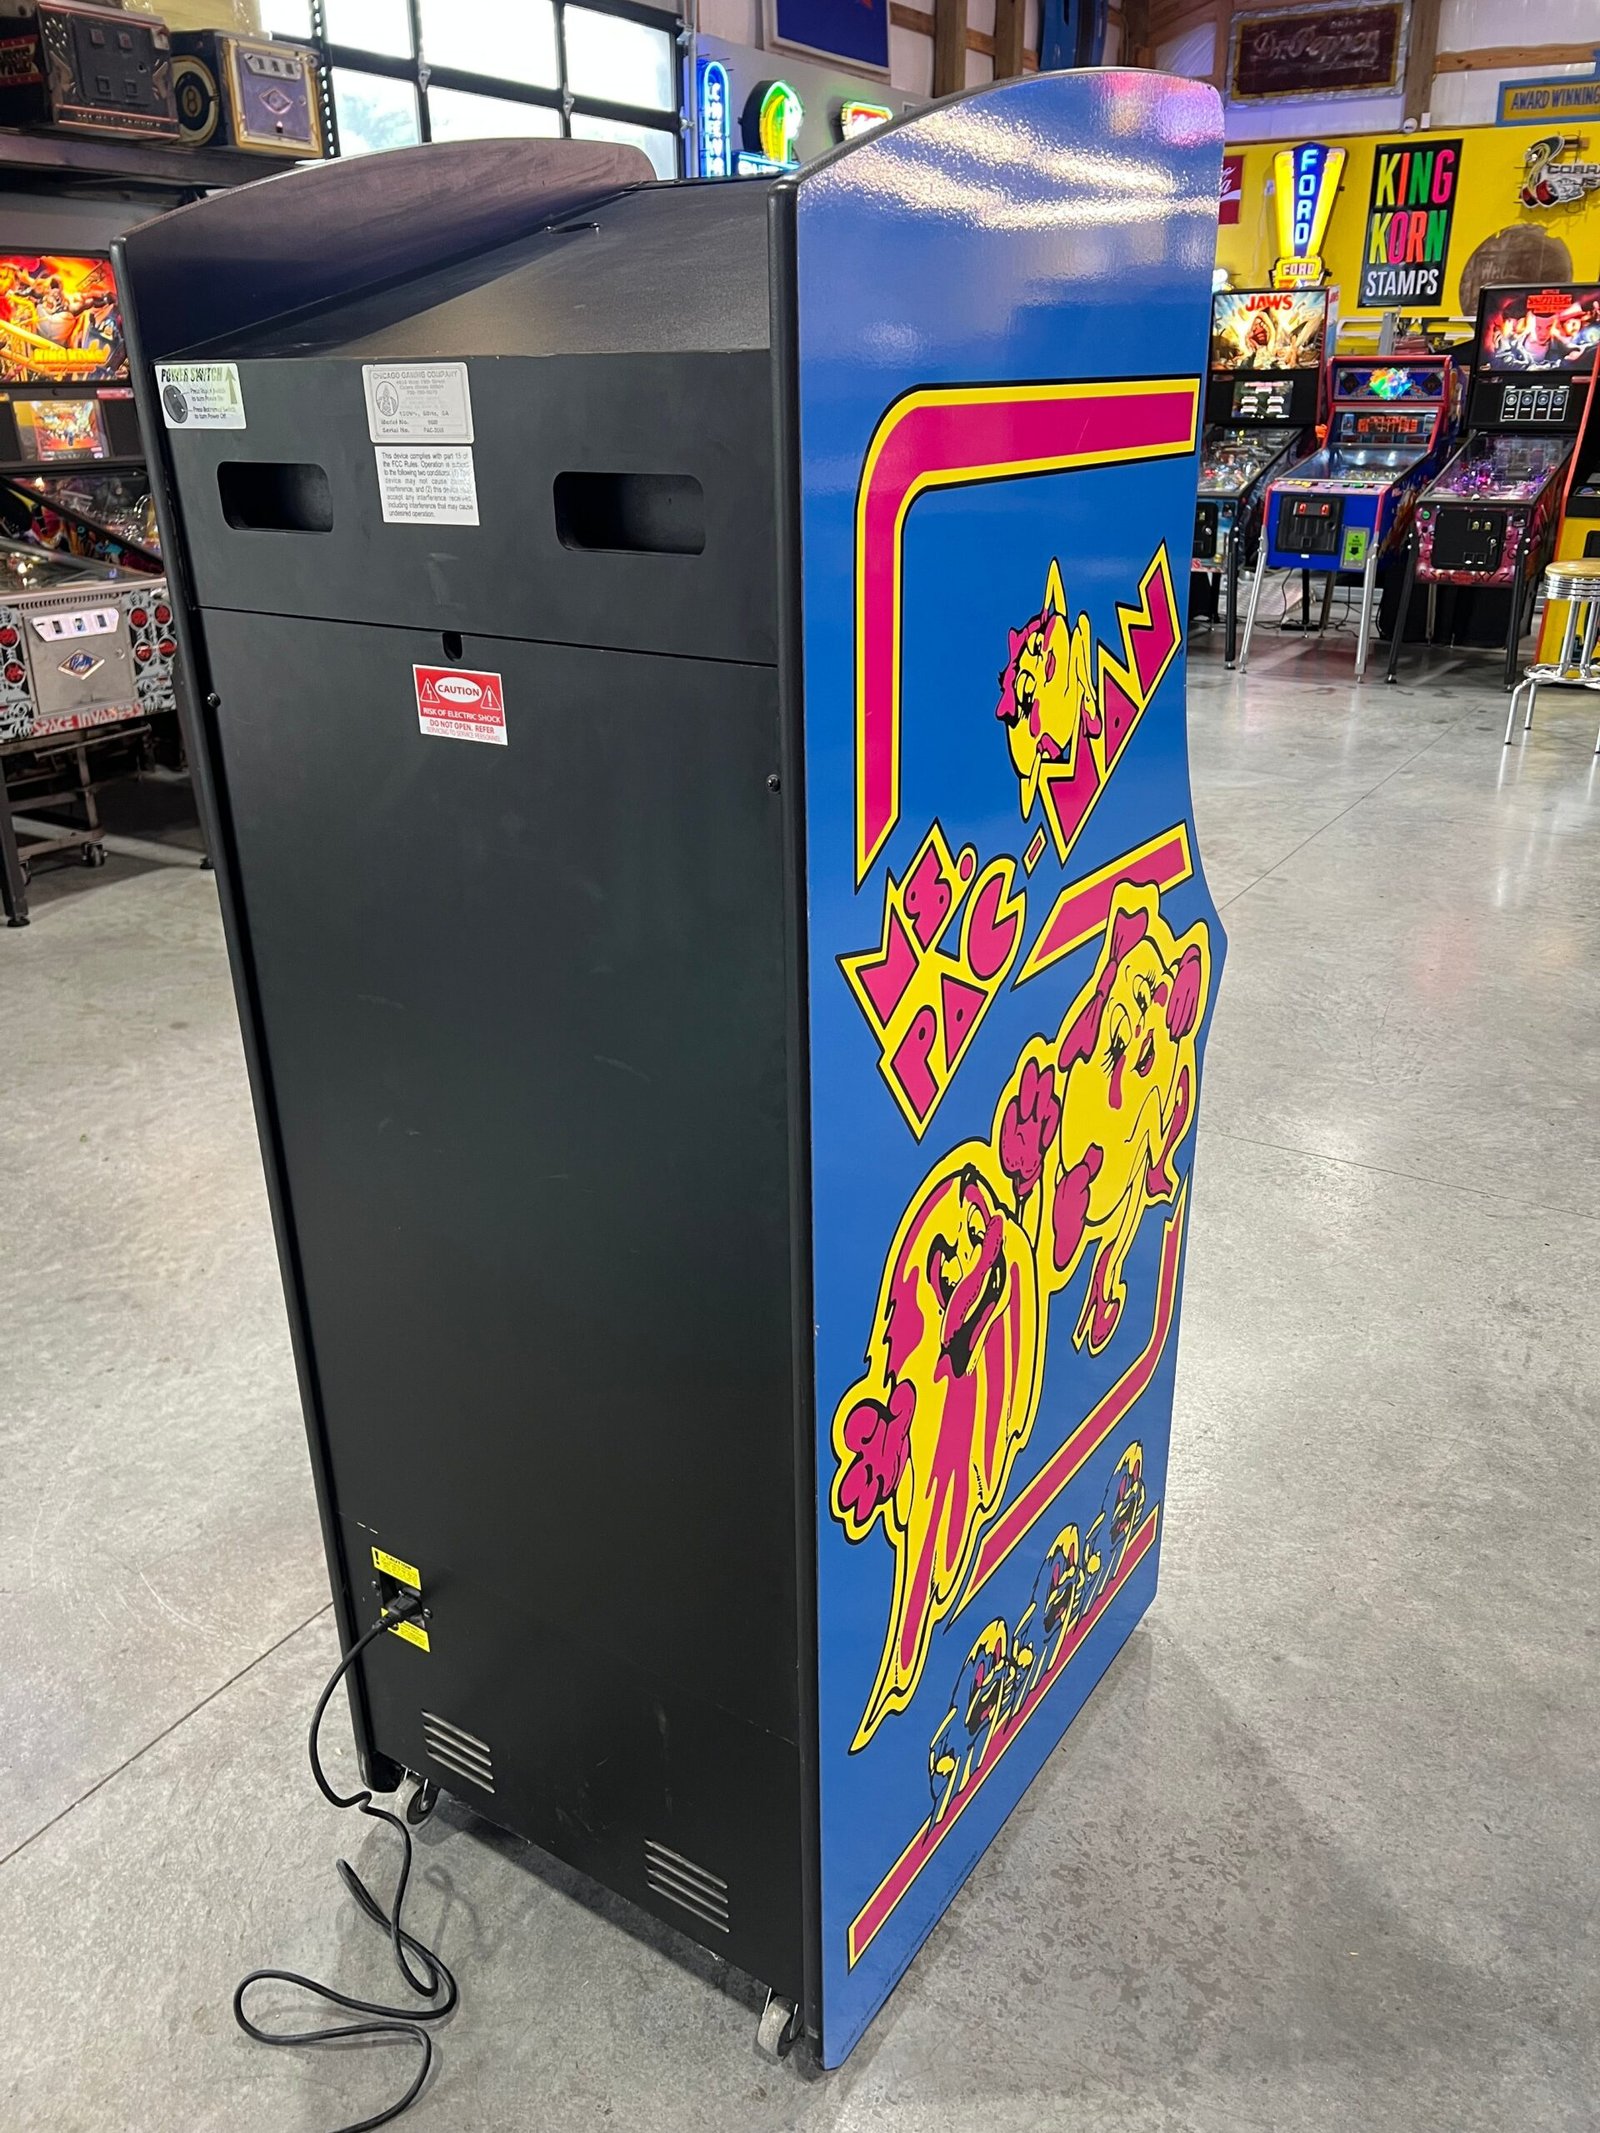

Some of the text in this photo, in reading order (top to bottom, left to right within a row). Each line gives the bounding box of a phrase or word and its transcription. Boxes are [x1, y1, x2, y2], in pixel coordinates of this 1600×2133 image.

[1510, 90, 1550, 111] AWARD
[1547, 164, 1600, 174] COBR
[1375, 149, 1456, 207] KING
[1293, 149, 1319, 245] FORD
[1369, 209, 1448, 266] KORN
[1282, 262, 1316, 276] FORD
[1365, 268, 1440, 297] STAMPS
[1245, 294, 1294, 312] JAWS
[161, 367, 223, 382] POWER SWITCH
[427, 370, 457, 378] COMPANY
[420, 460, 444, 468] Operation
[387, 501, 408, 509] including
[408, 502, 436, 510] interference
[416, 494, 447, 502] interference
[437, 683, 480, 697] CAUTION
[423, 707, 437, 715] RISK
[448, 710, 476, 720] ELECTRIC
[478, 714, 501, 723] SHOCK
[32, 714, 74, 737] SPACE
[475, 725, 494, 734] REFER
